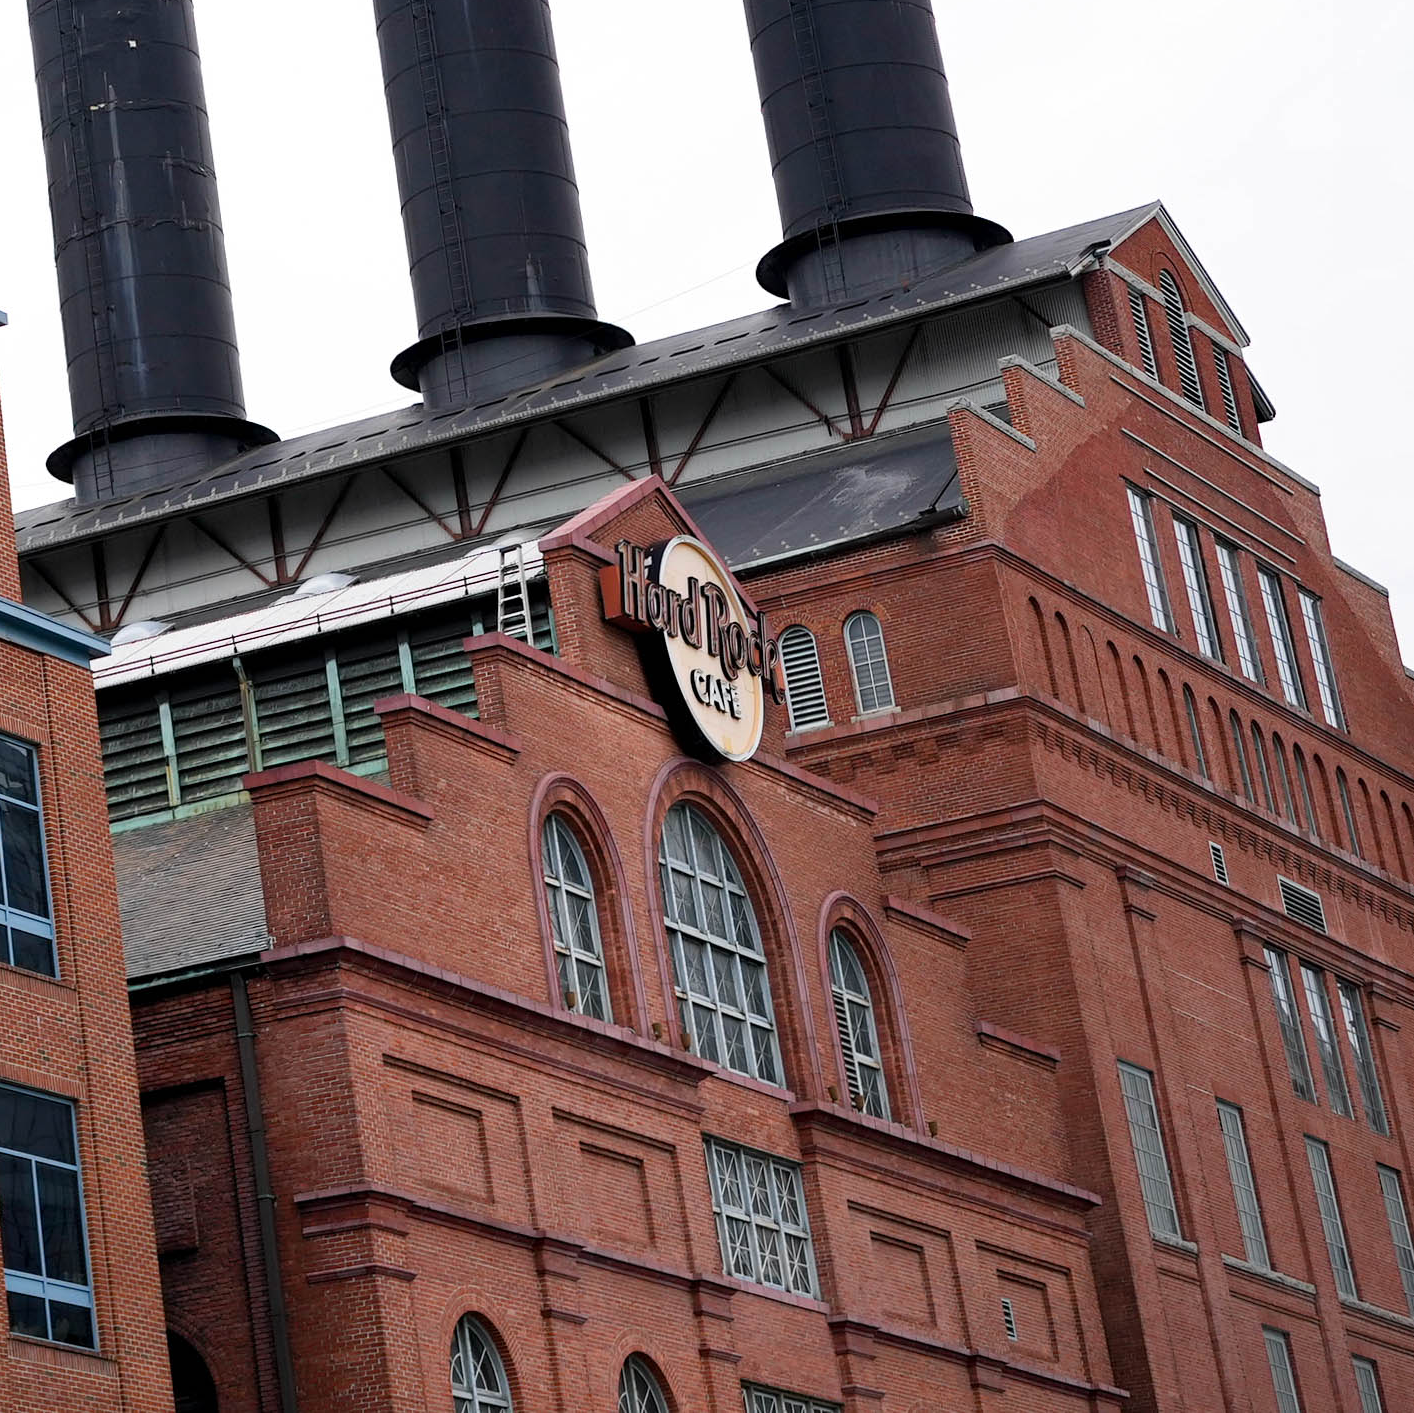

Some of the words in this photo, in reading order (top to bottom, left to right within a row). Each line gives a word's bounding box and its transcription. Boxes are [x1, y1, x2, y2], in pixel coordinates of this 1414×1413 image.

[617, 539, 702, 651] Hard
[702, 581, 786, 706] Rock
[691, 668, 742, 720] CAFE
